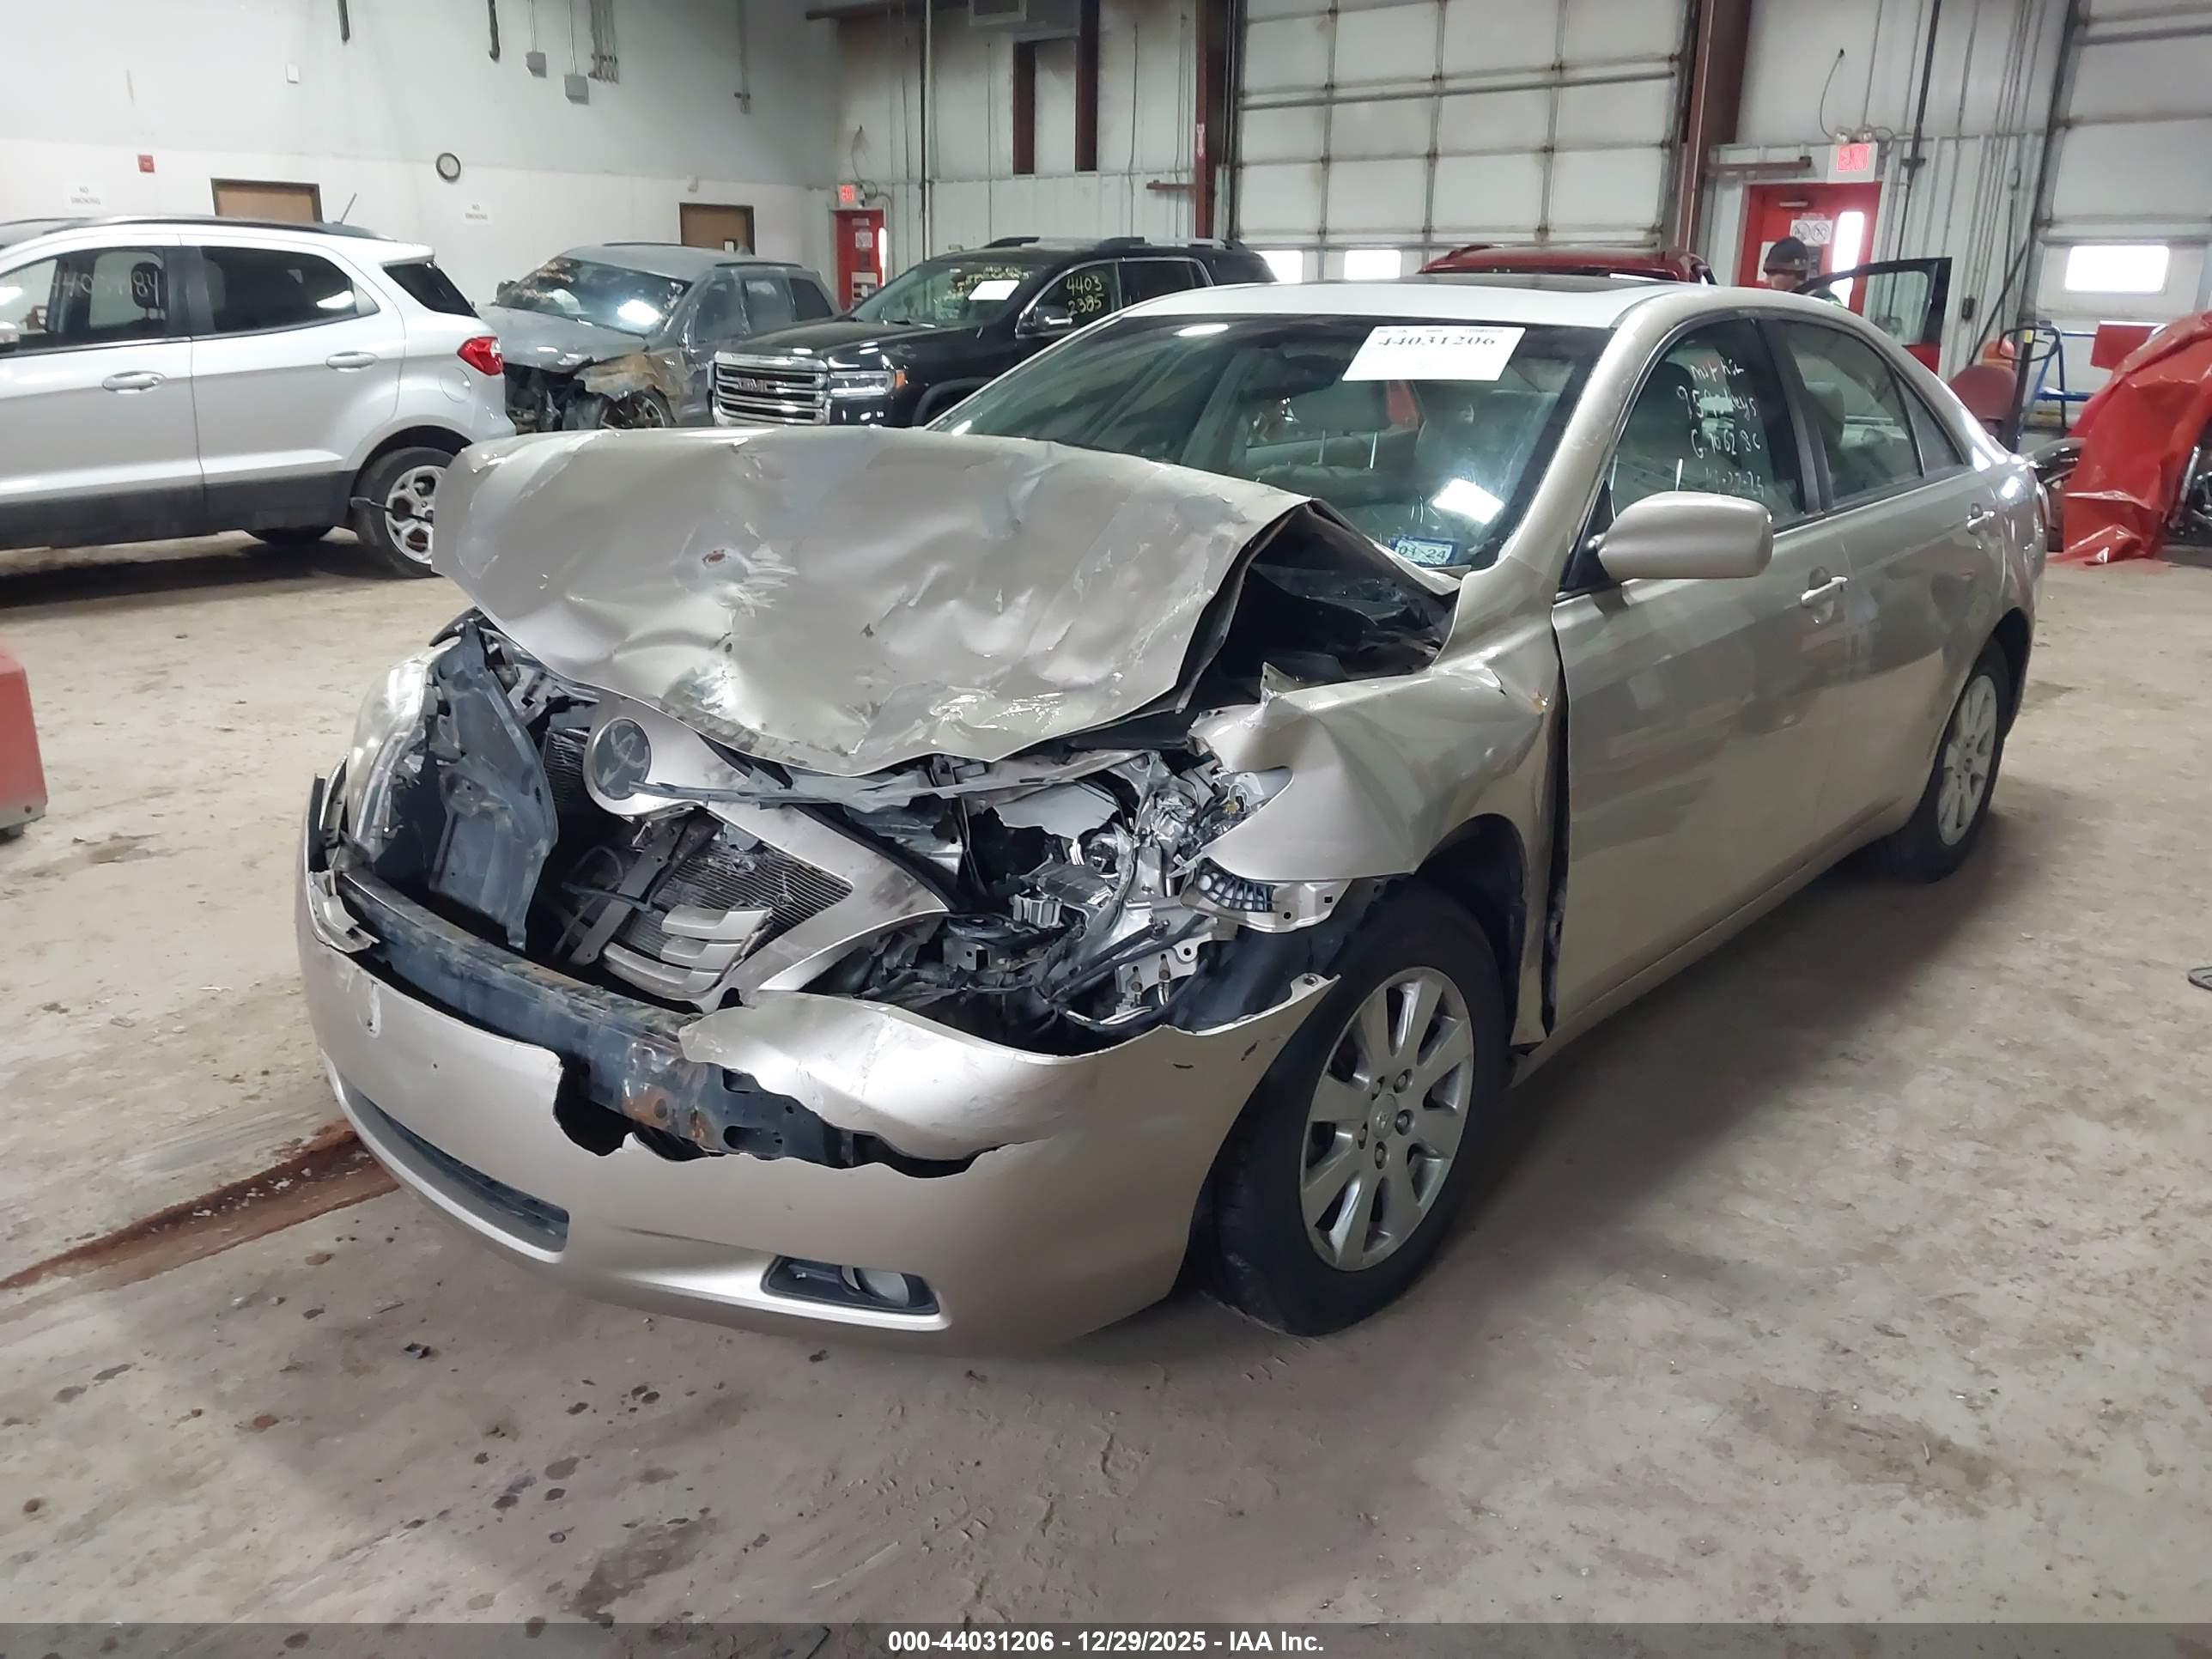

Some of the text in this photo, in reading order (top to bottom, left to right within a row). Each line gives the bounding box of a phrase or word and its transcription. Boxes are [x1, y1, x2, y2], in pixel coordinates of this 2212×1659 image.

[1837, 144, 1869, 172] EXIT
[1066, 275, 1103, 296] 4403
[1067, 295, 1105, 315] 2385
